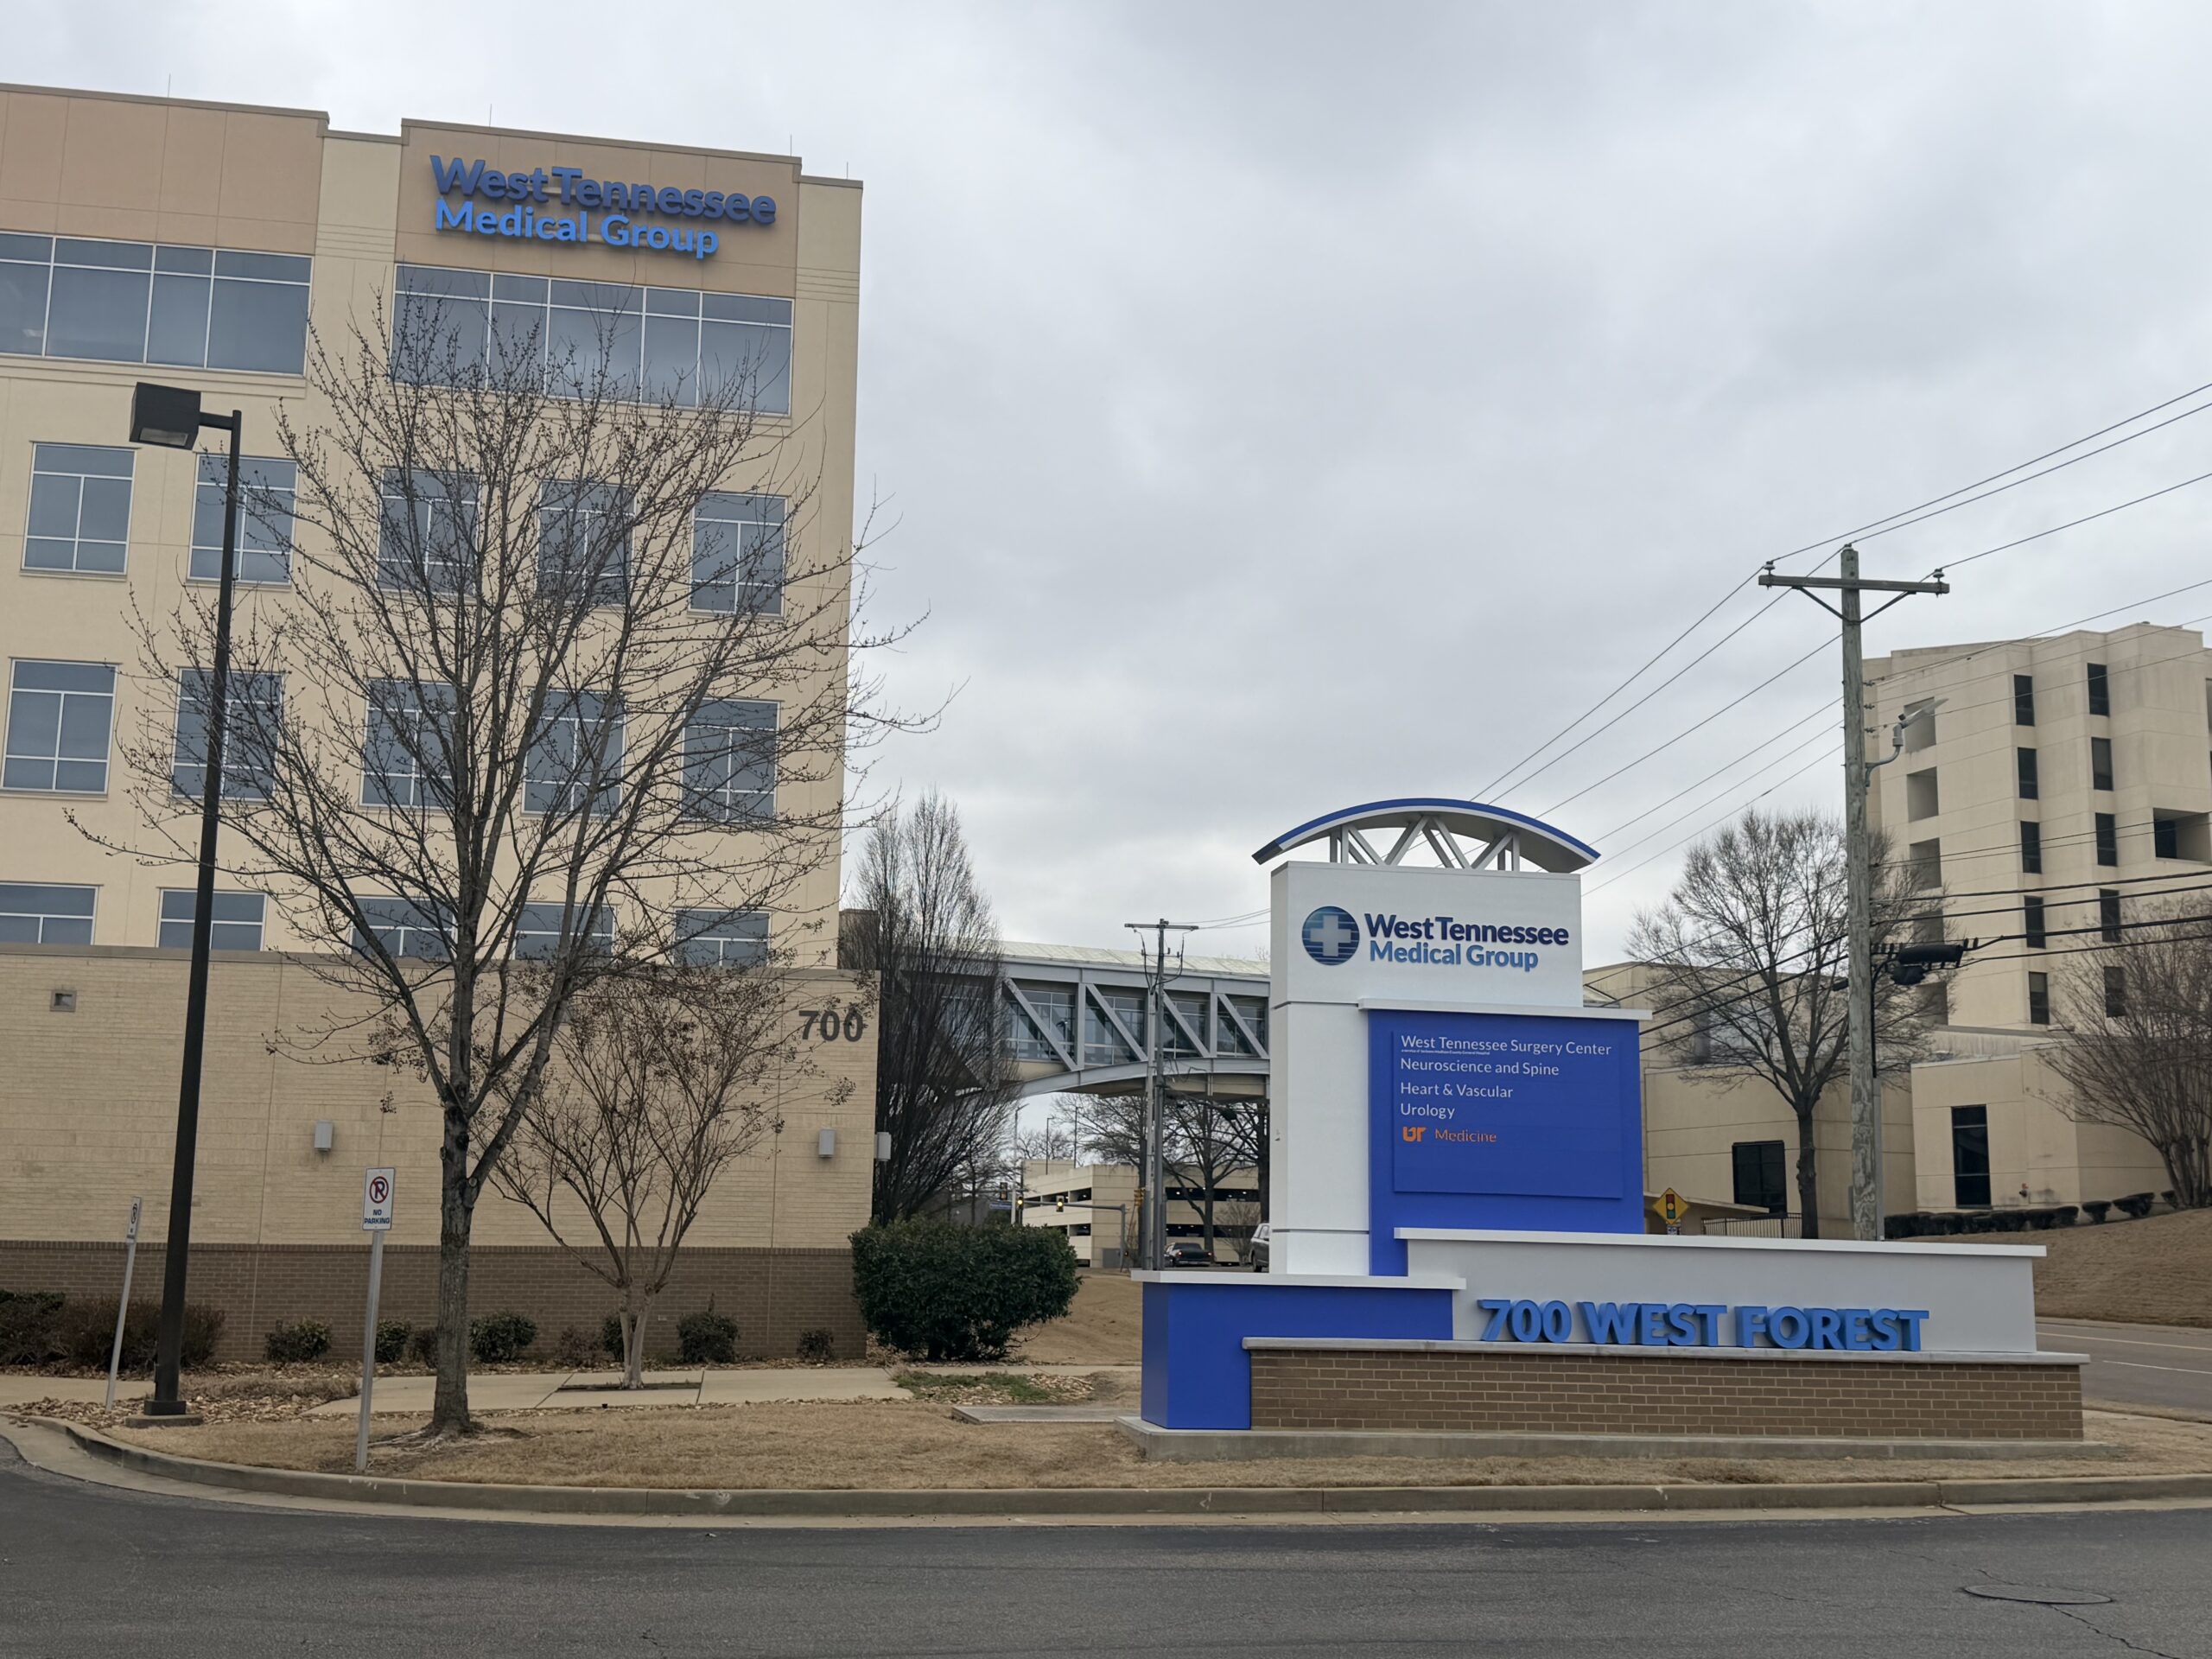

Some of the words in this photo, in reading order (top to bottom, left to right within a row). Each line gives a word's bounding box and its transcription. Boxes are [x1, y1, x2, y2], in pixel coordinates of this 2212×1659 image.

[429, 154, 549, 204] West
[551, 165, 777, 225] Tennessee
[435, 197, 588, 243] Medical
[600, 213, 719, 259] Group
[1363, 912, 1434, 940] West
[1434, 916, 1570, 946] Tennessee
[1370, 940, 1462, 965] Medical
[1465, 944, 1539, 973] Group
[798, 1009, 863, 1043] 700
[1401, 1034, 1436, 1049] West
[1438, 1036, 1508, 1052] Tennessee
[1510, 1039, 1563, 1056] Surgery
[1566, 1041, 1612, 1055] Center
[1400, 1058, 1492, 1074] Neuroscience
[1494, 1061, 1520, 1075] and
[1522, 1063, 1560, 1077] Spine
[1400, 1082, 1440, 1096] Heart
[1442, 1083, 1453, 1096] &
[1456, 1084, 1514, 1098] Vascular
[1400, 1103, 1456, 1120] Urology
[1434, 1128, 1497, 1143] Medicine
[1477, 1299, 1572, 1343] 700
[1576, 1300, 1728, 1346] WEST
[1734, 1305, 1929, 1351] FOREST
